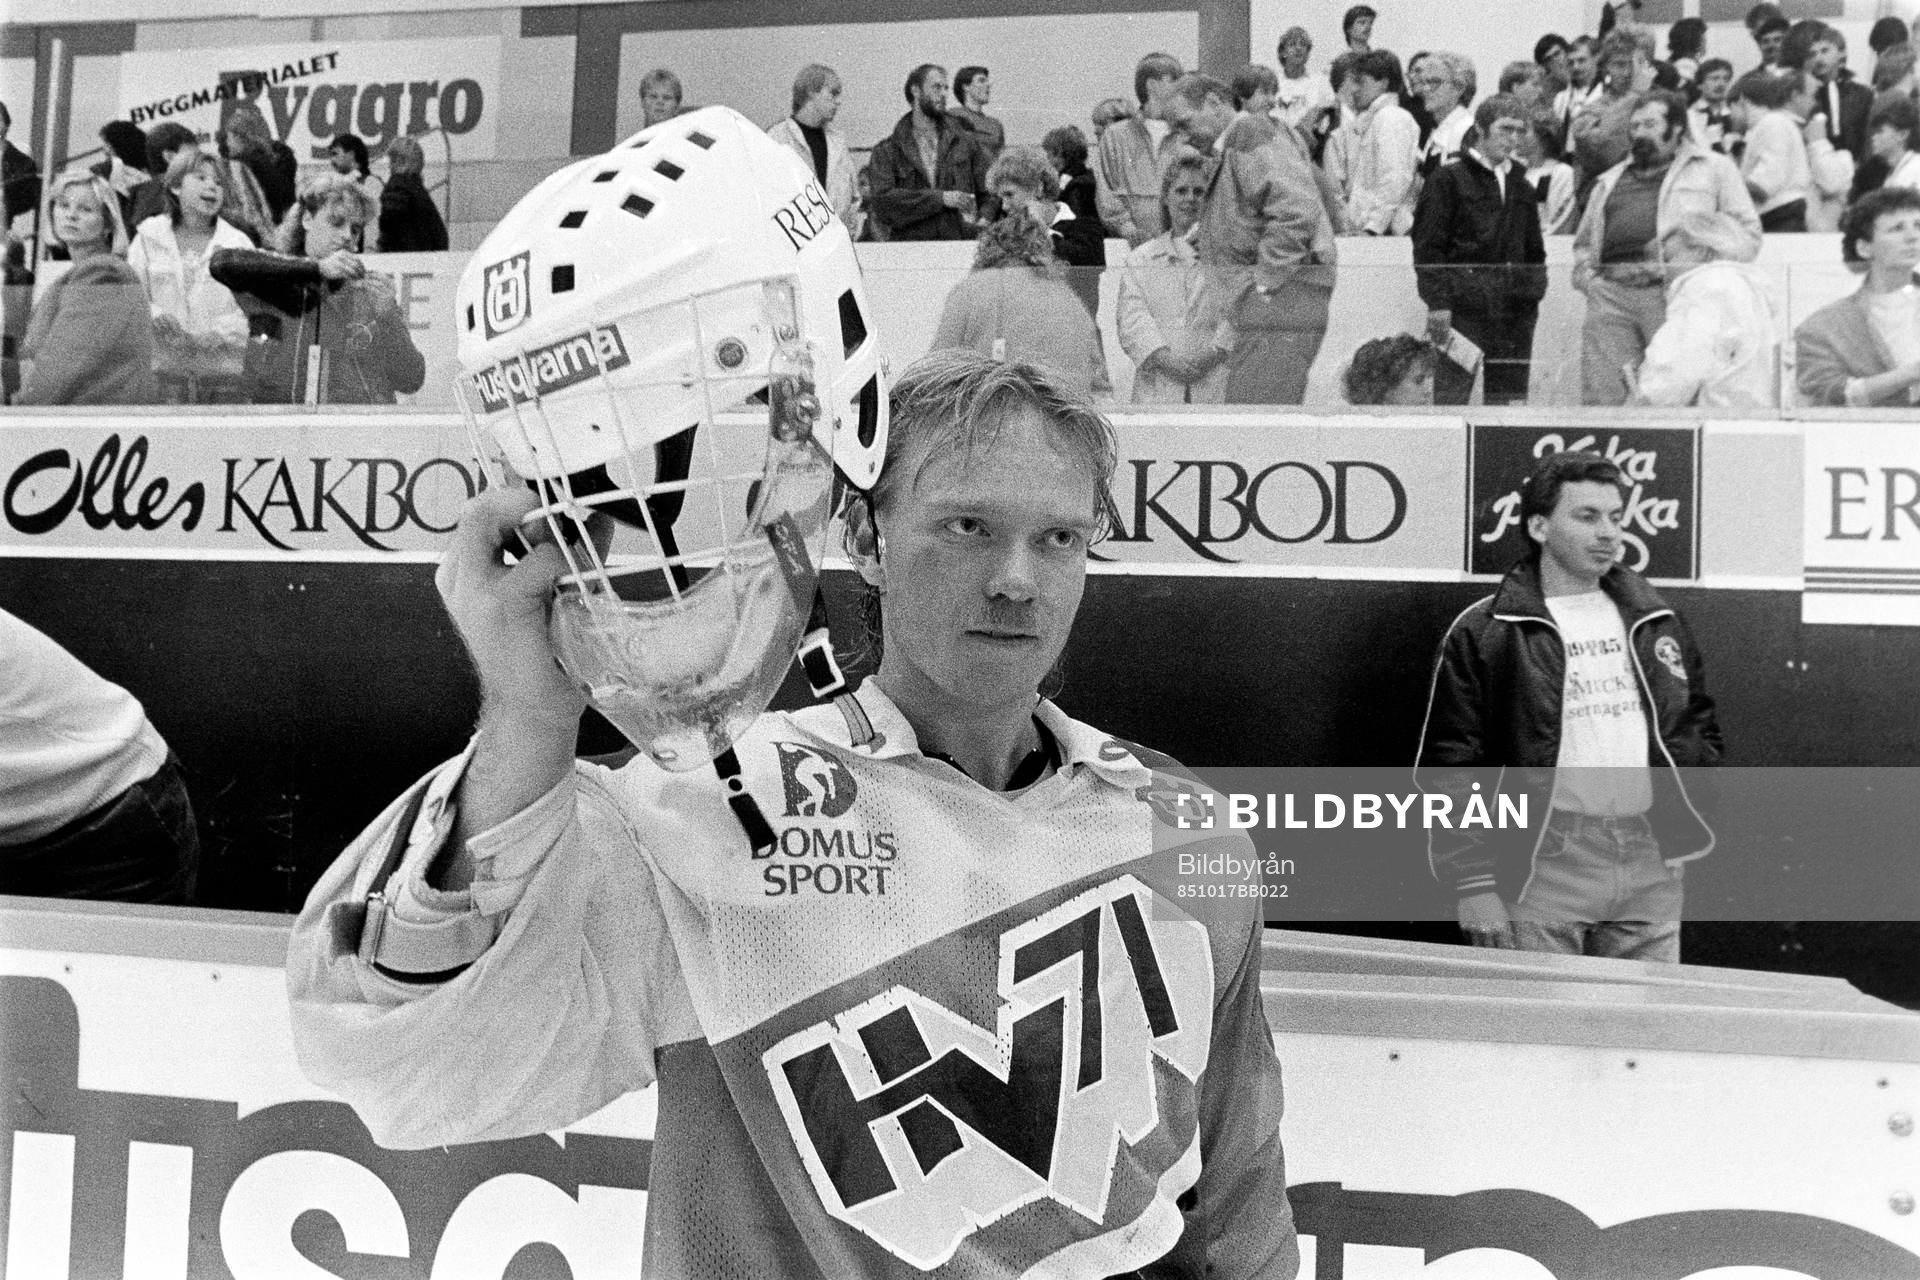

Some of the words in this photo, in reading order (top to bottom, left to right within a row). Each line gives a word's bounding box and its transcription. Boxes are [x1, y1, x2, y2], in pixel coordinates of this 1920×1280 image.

[473, 328, 624, 405] Husqvarna
[4, 434, 205, 534] Olles
[216, 457, 502, 551] KAKBO
[1087, 459, 1408, 563] KBOD
[763, 863, 892, 896] SPORT
[781, 891, 1181, 1210] HV71
